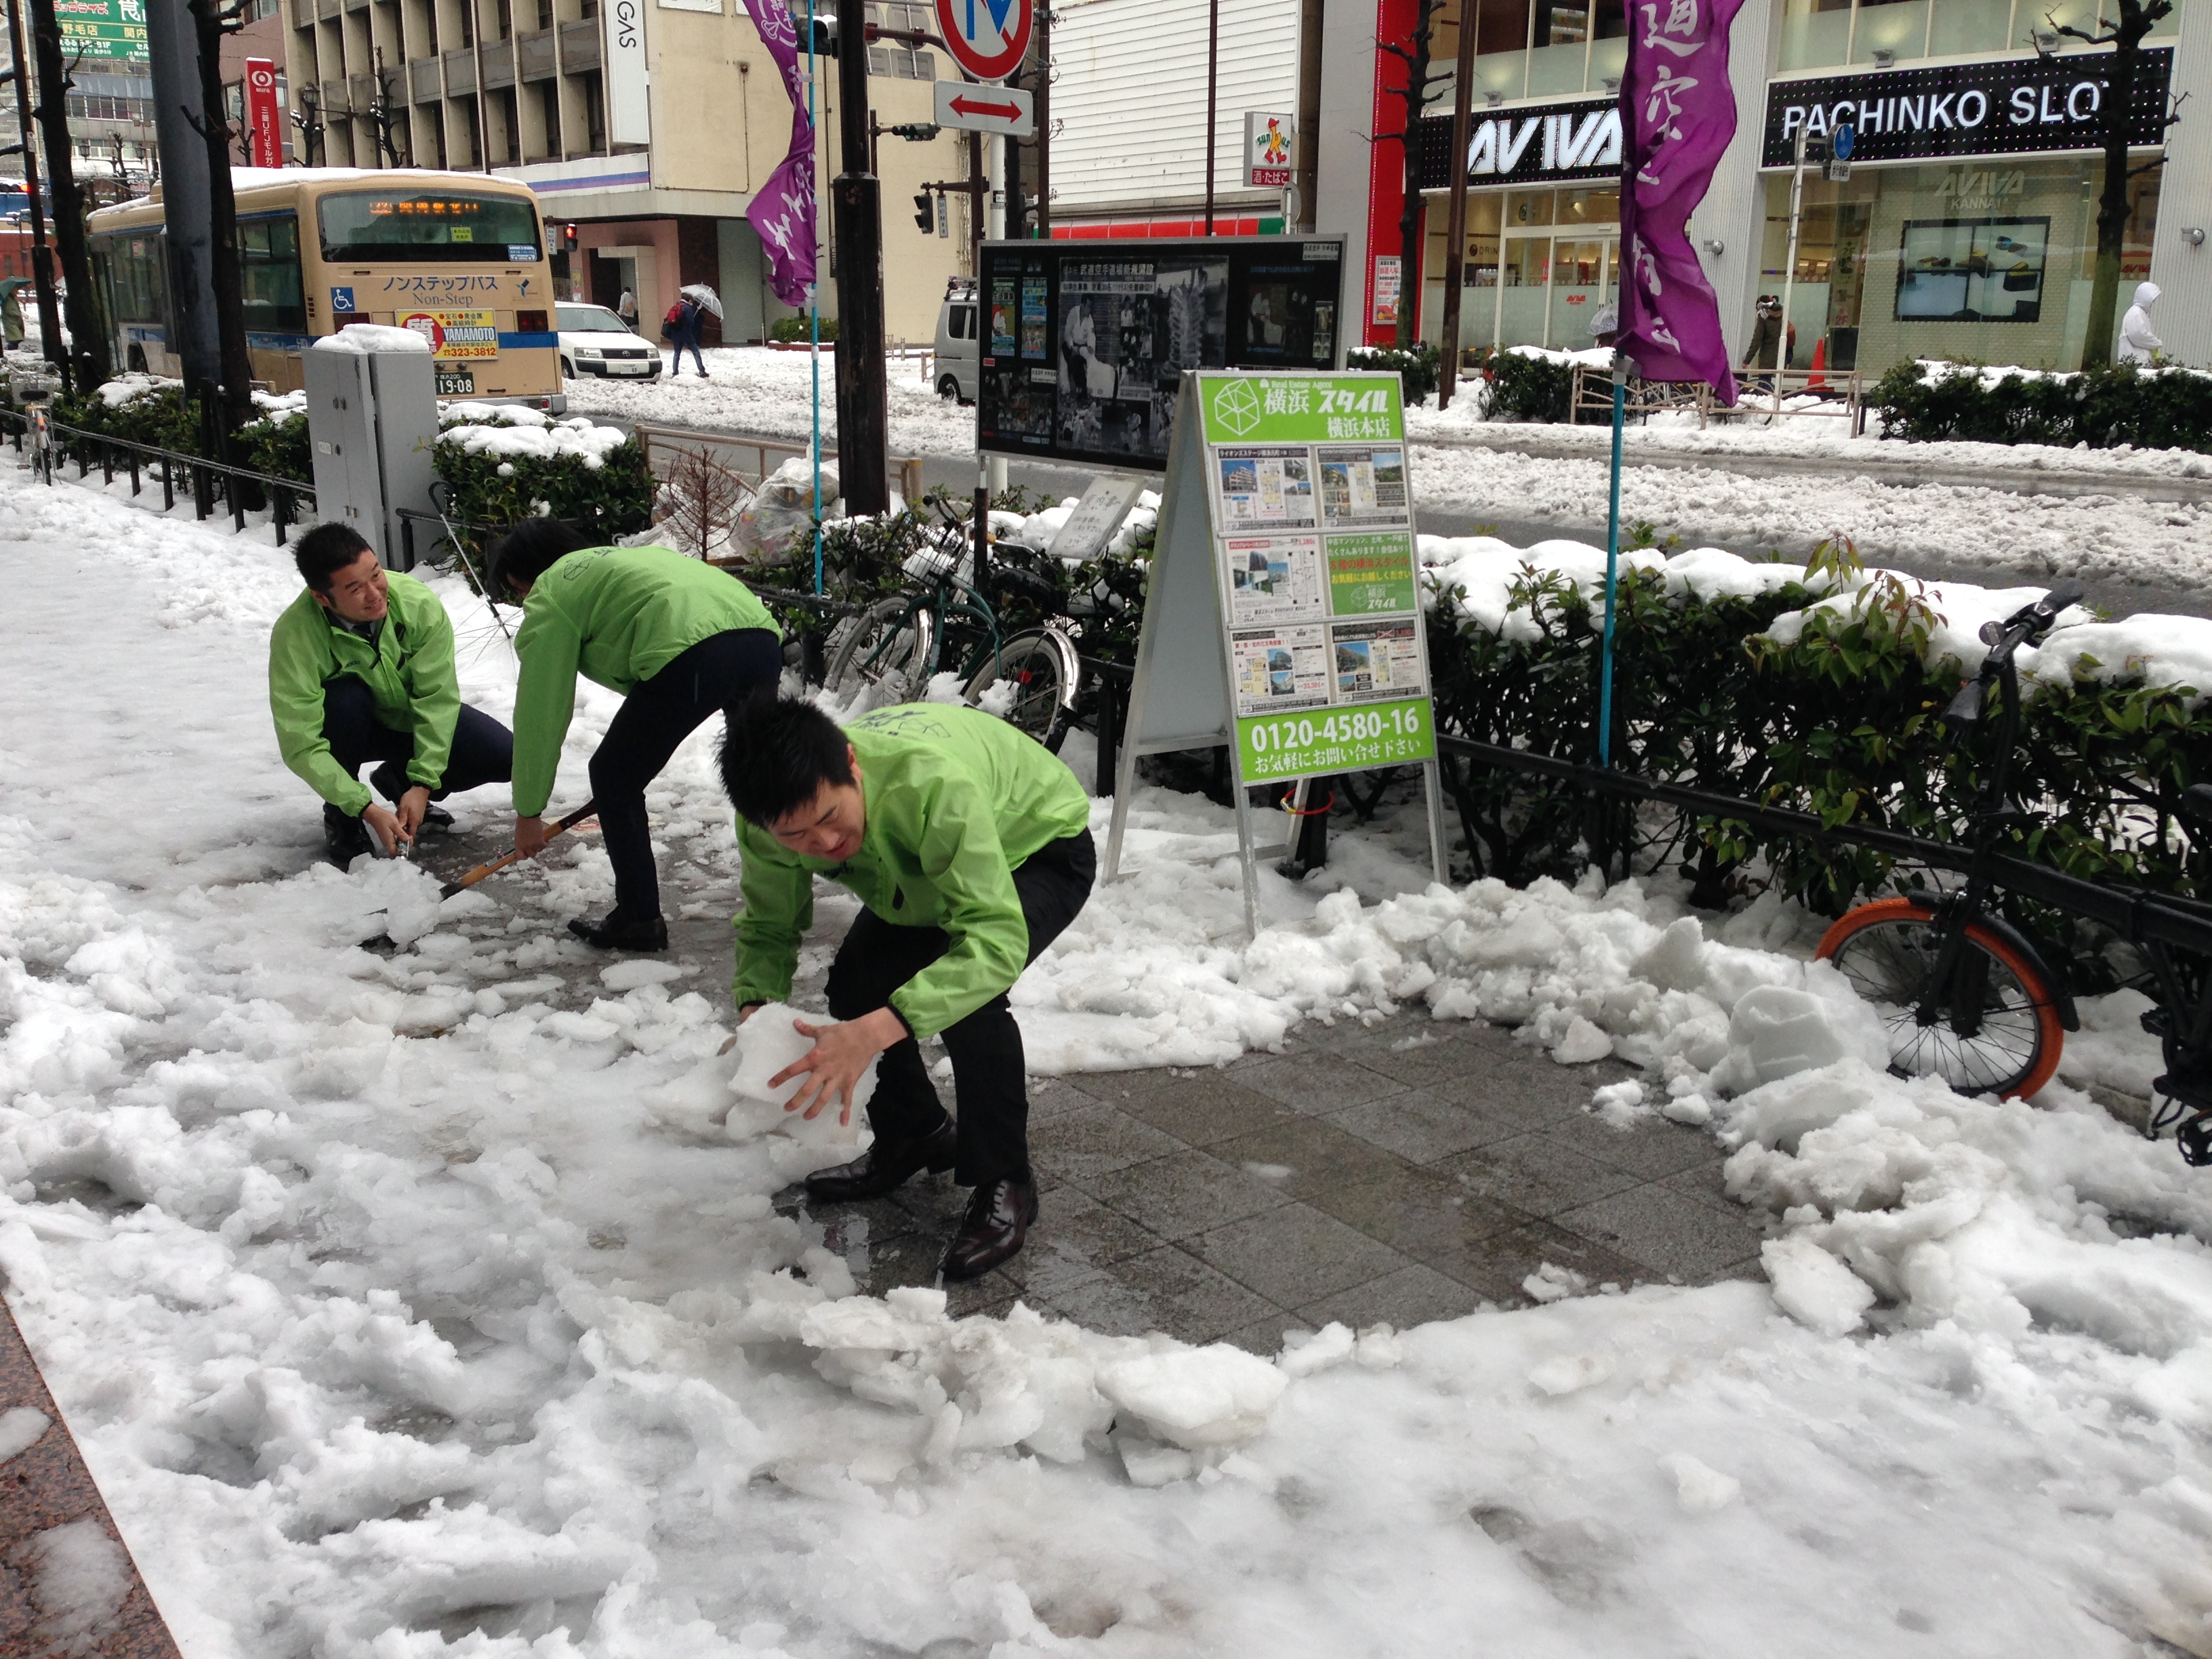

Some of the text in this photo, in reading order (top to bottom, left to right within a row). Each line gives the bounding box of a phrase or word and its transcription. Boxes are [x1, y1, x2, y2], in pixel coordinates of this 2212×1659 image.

[617, 1, 637, 49] GAS
[1783, 81, 2110, 140] PACHINKO SLO
[1468, 106, 1624, 175] AVIVA
[1934, 169, 2025, 197] AVIVA
[1479, 246, 1500, 254] DRIN
[383, 276, 498, 291] ノンステップバス
[412, 292, 474, 308] Non-Step
[443, 327, 495, 342] YAMAMOTO
[450, 348, 497, 357] 323-3812
[1263, 388, 1389, 415] 横浜 スタイル
[1327, 415, 1390, 438] 横浜本店
[1251, 707, 1420, 753] 0120-4580-16
[1254, 739, 1421, 774] お気軽にお問い合せ下さい
